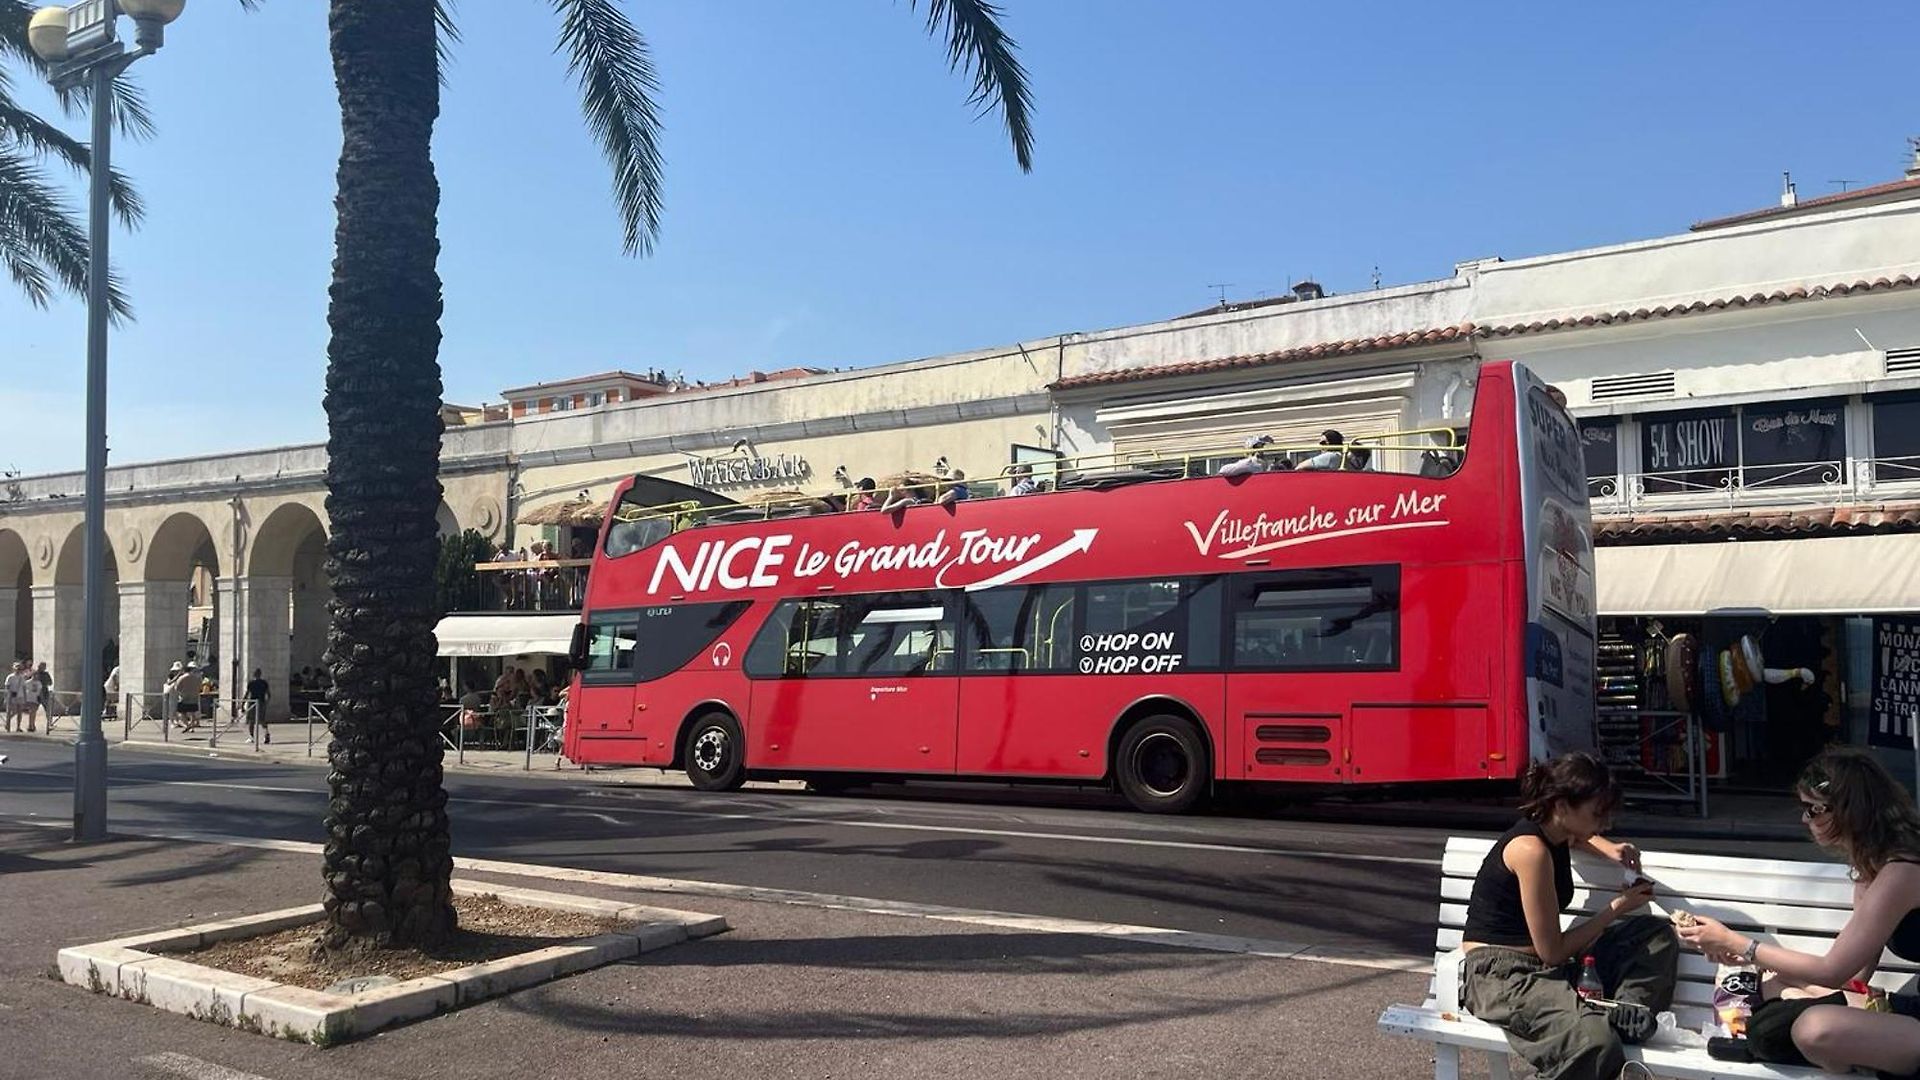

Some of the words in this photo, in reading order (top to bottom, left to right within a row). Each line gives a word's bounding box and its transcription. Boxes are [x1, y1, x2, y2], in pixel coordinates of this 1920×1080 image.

[1650, 424, 1668, 468] 54
[1676, 418, 1725, 467] SHOW
[687, 457, 753, 486] WAKA
[753, 453, 806, 480] BAR
[1184, 506, 1339, 556] Villefranche
[1344, 502, 1386, 526] sur
[1391, 489, 1447, 519] Mer
[647, 534, 793, 595] NICE
[834, 528, 950, 579] Grand
[957, 528, 1042, 565] Tour
[1095, 633, 1140, 652] HOP
[1141, 632, 1175, 650] ON
[1094, 655, 1139, 674] HOP
[1141, 654, 1182, 673] OFF
